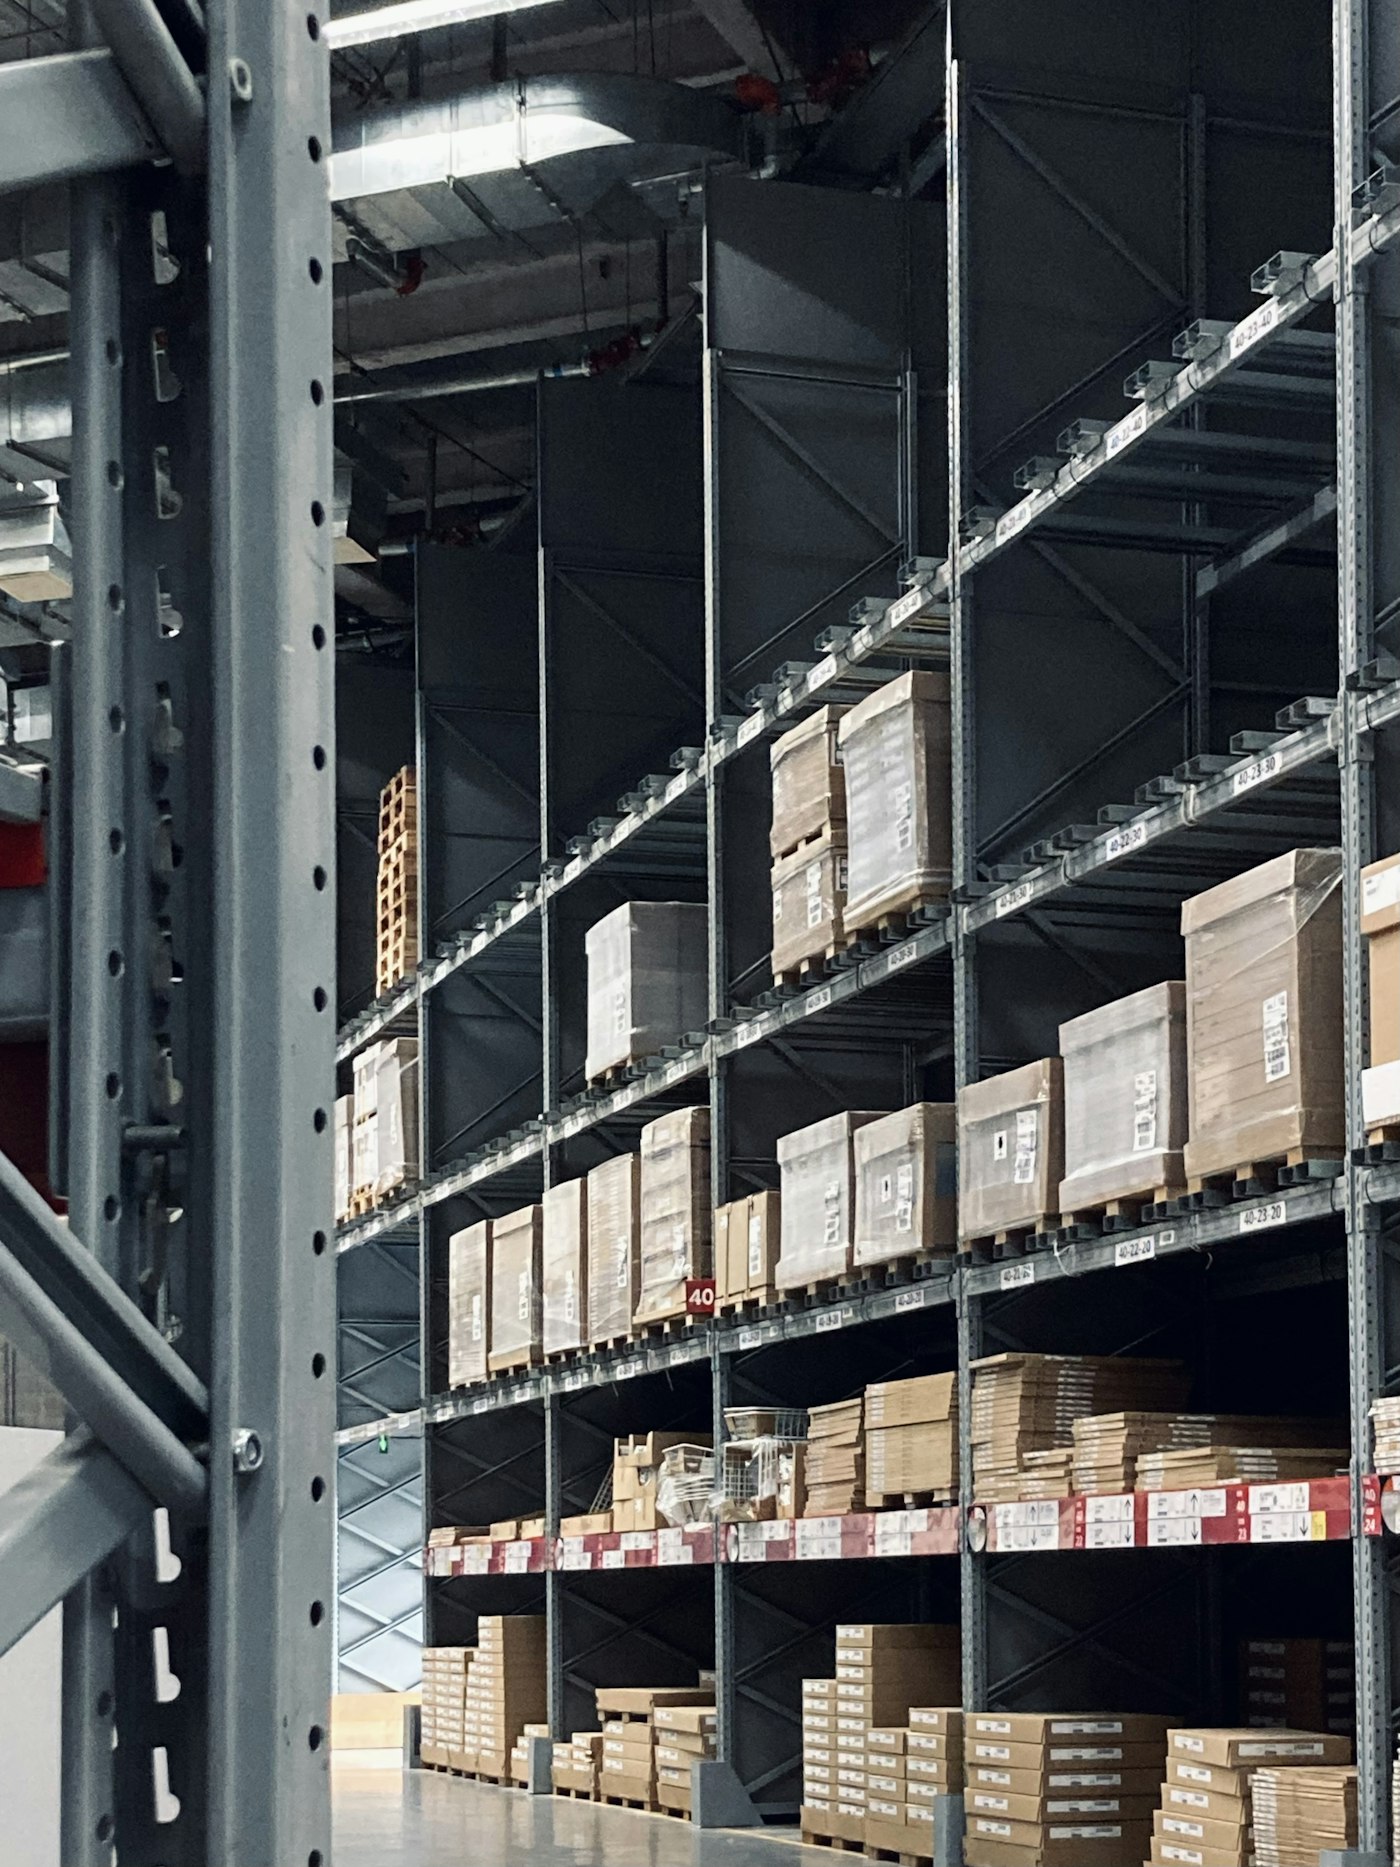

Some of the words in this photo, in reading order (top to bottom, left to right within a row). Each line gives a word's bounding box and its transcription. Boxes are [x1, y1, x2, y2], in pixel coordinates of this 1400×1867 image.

[1238, 756, 1276, 786] 40-23-30
[1110, 827, 1142, 852] 40-22-30
[1244, 1204, 1282, 1225] 40-23-20
[1118, 1240, 1152, 1259] 40-22-20
[688, 1288, 715, 1306] 40
[1237, 1527, 1247, 1541] 23
[1364, 1518, 1376, 1532] 24
